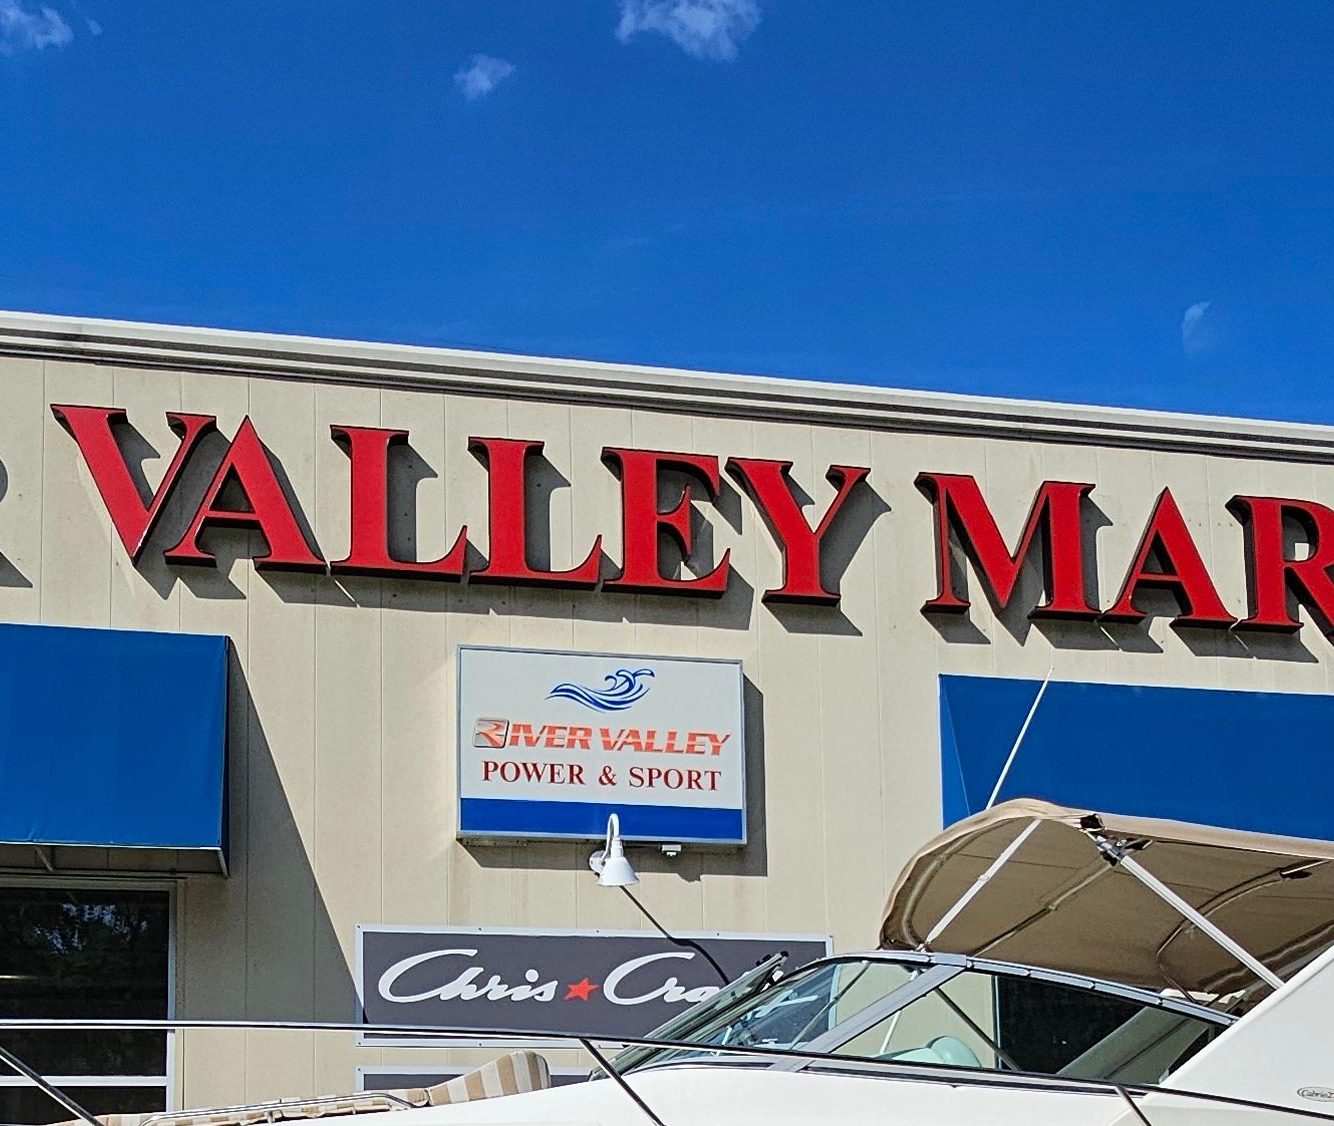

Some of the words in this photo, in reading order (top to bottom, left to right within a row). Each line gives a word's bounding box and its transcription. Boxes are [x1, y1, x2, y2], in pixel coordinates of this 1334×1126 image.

[50, 402, 871, 606] VALLEY
[473, 718, 593, 750] RIVER
[600, 727, 732, 756] VALLEY
[482, 760, 587, 786] POWER
[598, 765, 617, 787] &
[628, 766, 723, 791] SPORT
[378, 949, 558, 1003] Chris
